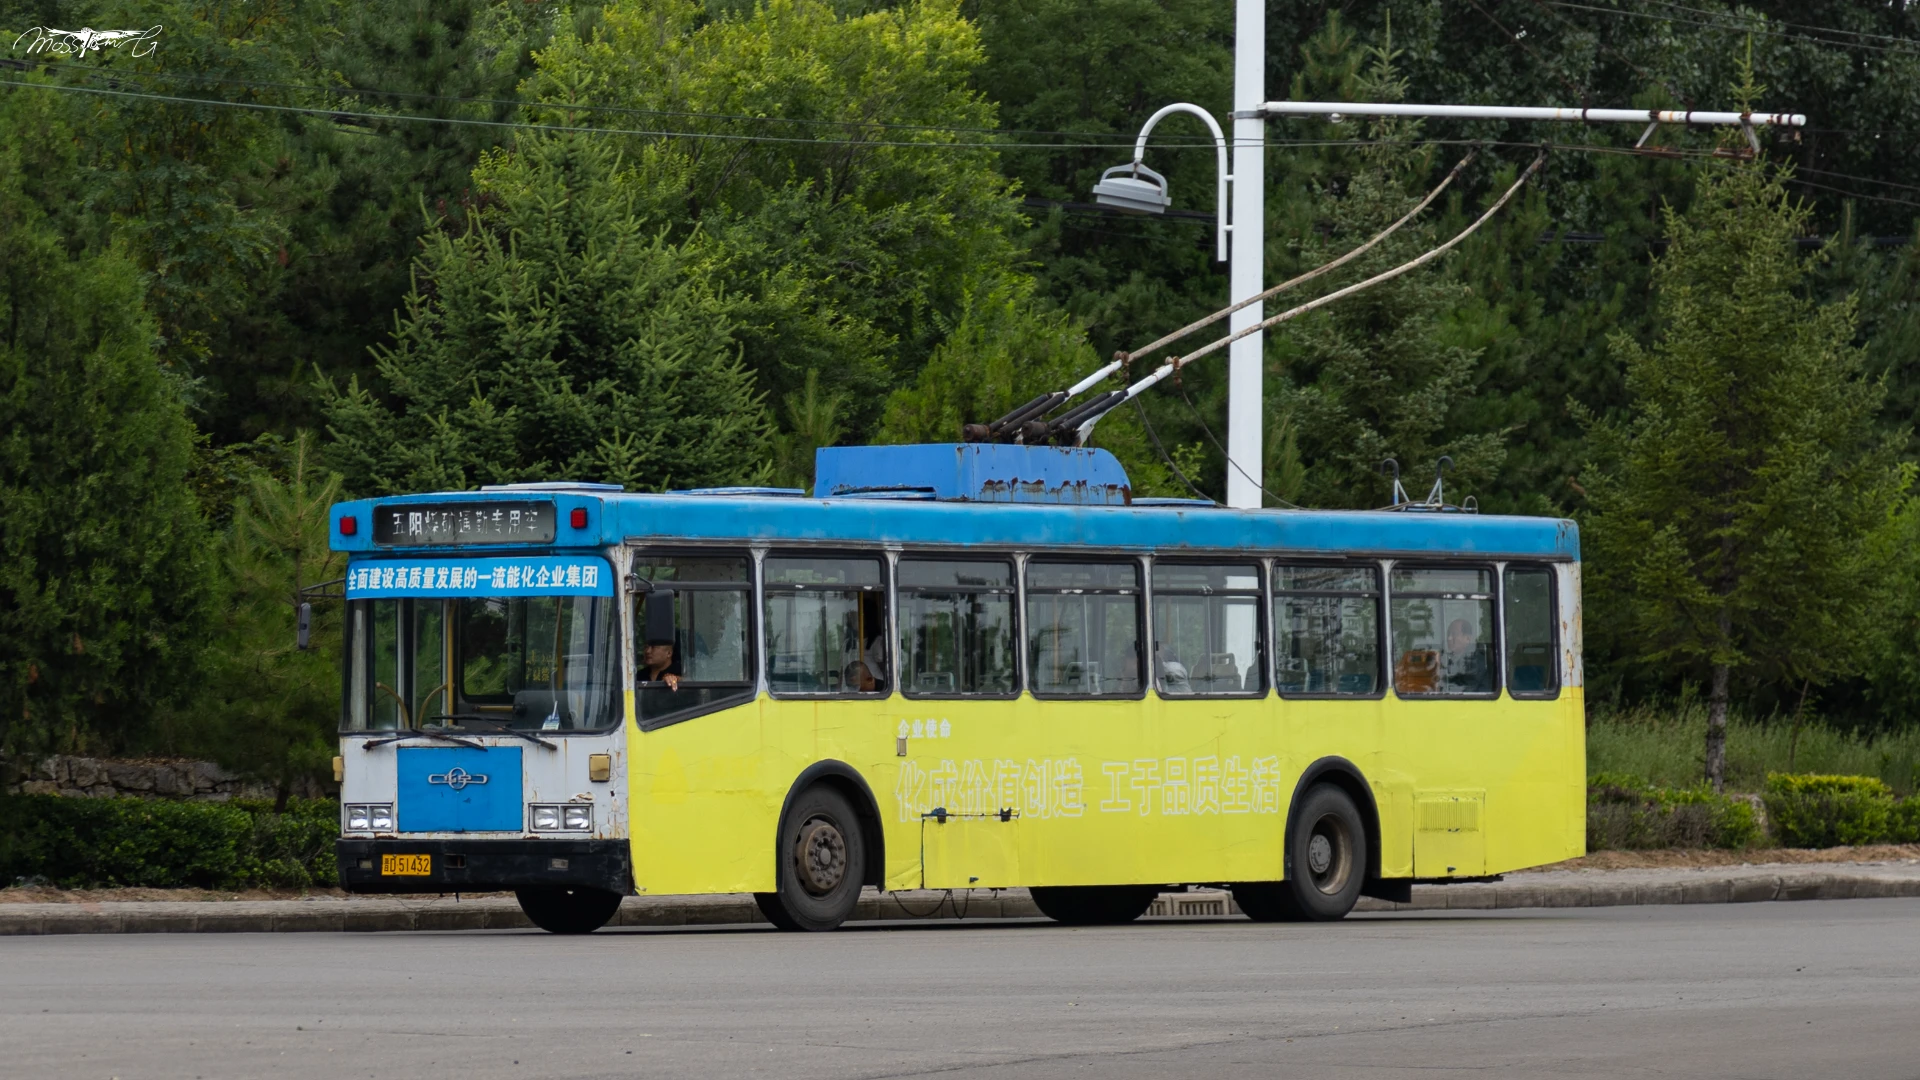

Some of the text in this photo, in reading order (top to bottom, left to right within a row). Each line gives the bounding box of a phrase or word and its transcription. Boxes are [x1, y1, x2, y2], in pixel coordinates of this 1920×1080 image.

[347, 564, 599, 591] 全面建设高质量发展的一流能化企业集团
[897, 718, 952, 739] 企业使命
[895, 755, 1282, 822] 化成价值创造 工于品质生活
